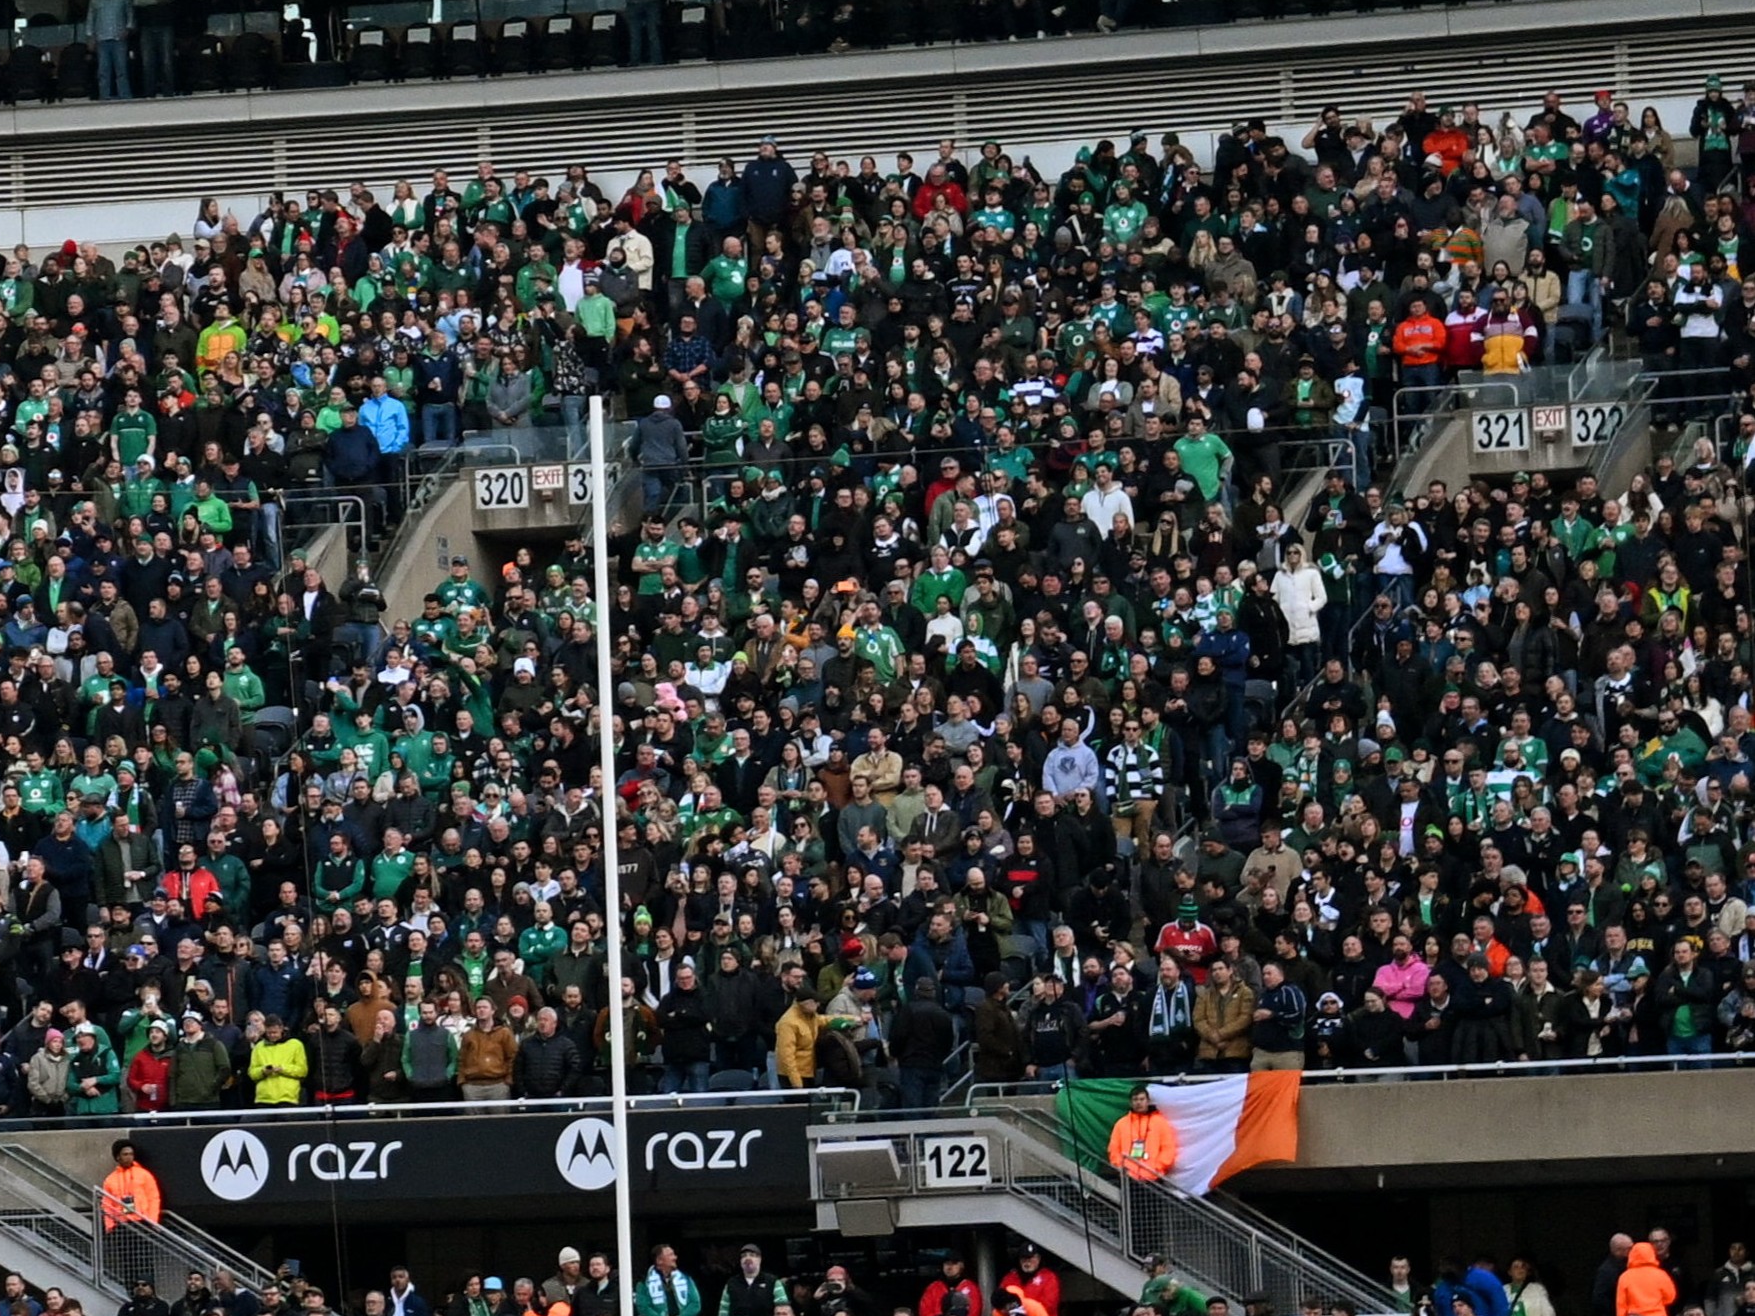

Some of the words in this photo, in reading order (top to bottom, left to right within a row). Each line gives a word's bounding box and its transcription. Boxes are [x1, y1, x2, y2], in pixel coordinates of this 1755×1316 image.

[1478, 412, 1526, 447] 321
[1535, 411, 1566, 427] EXIT
[1577, 407, 1623, 442] 322
[481, 472, 524, 505] 320
[535, 469, 562, 485] EXIT
[287, 1140, 404, 1182] razr
[644, 1129, 763, 1171] razr
[929, 1144, 987, 1179] 122
